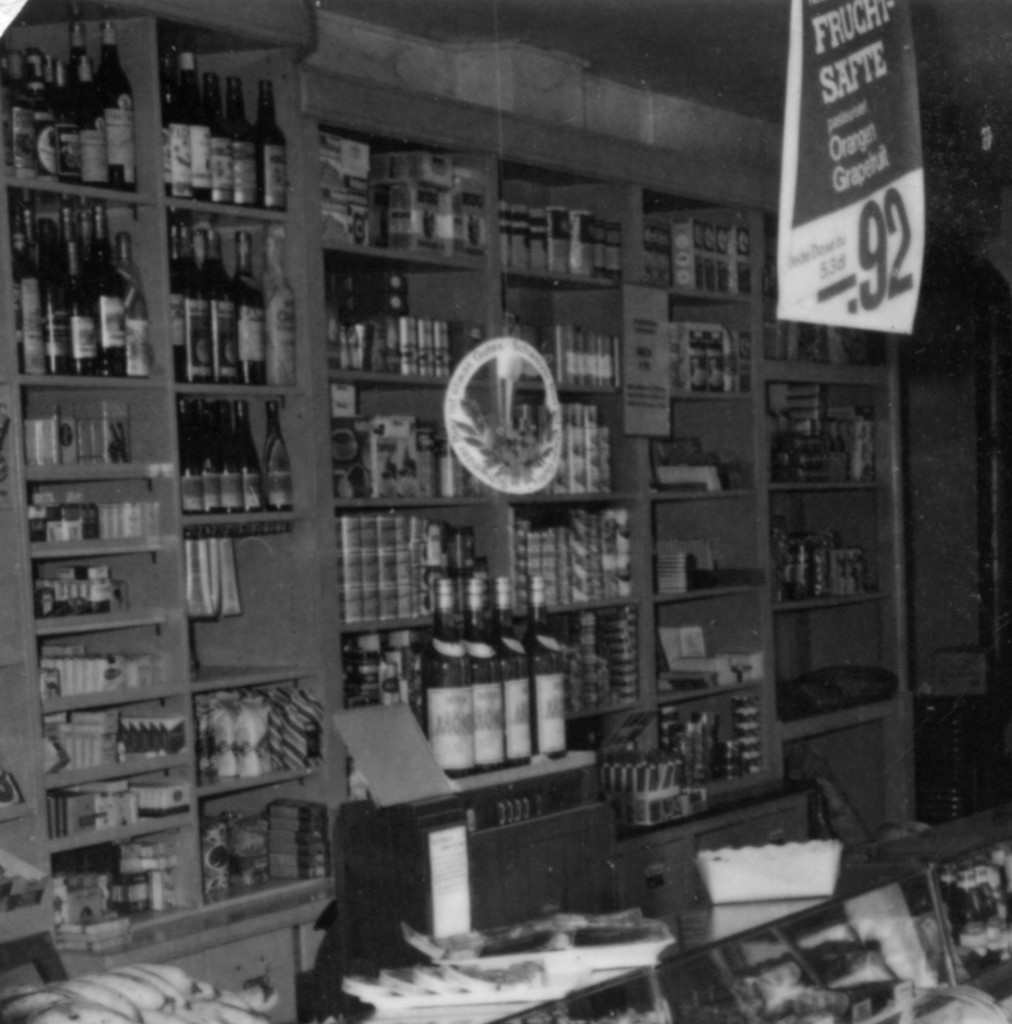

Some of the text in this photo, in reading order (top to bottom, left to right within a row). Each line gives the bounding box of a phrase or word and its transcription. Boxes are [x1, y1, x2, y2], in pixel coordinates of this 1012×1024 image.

[812, 0, 895, 54] FRUCHT-
[829, 122, 877, 161] Orangen
[832, 144, 889, 192] Grapefruit
